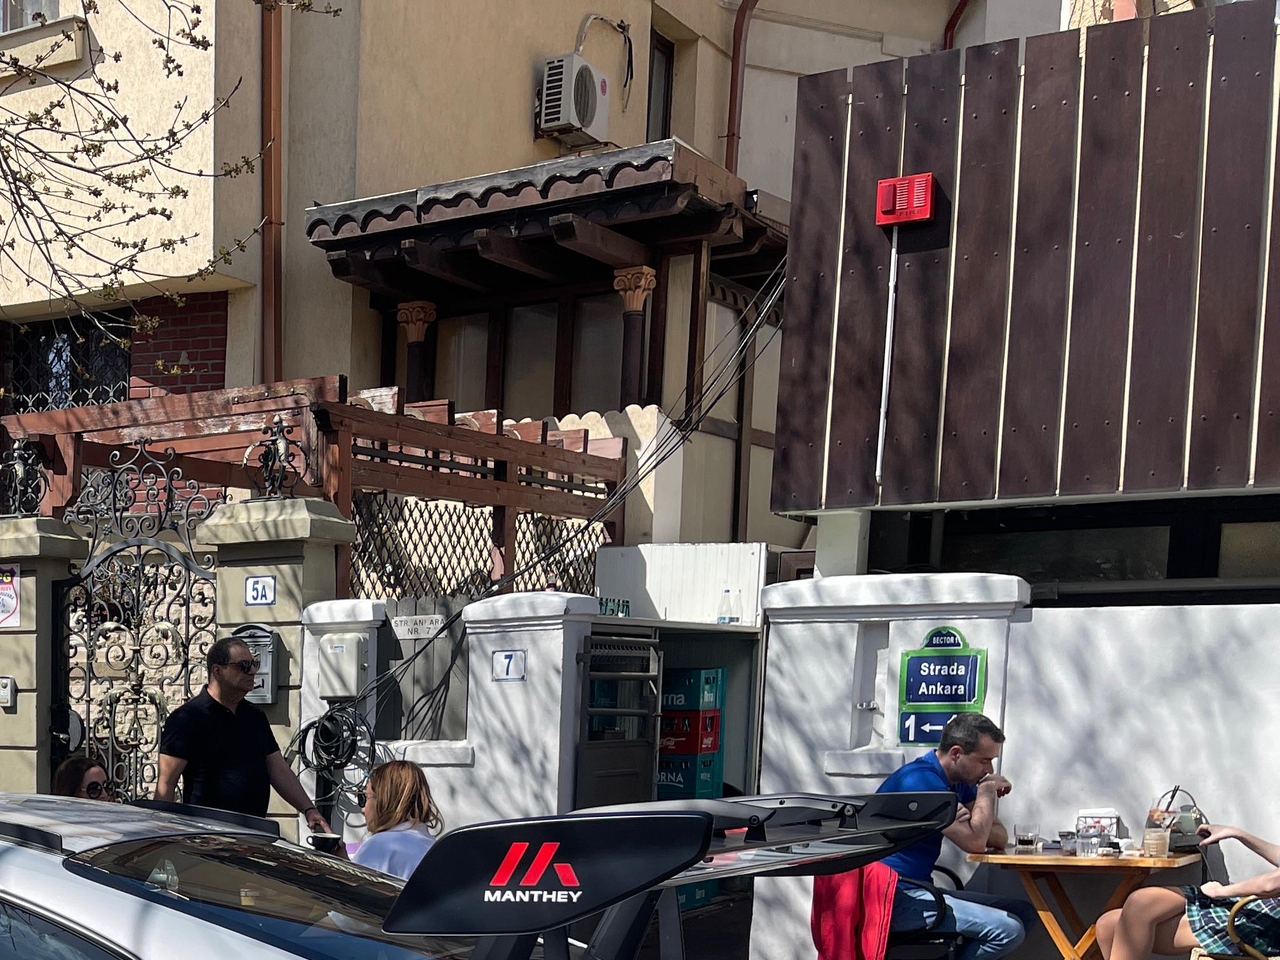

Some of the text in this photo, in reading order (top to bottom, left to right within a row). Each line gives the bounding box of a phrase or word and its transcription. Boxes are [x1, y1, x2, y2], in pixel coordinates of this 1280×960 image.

[252, 580, 267, 601] 5A
[932, 636, 955, 644] SECTOR
[504, 654, 513, 676] 7
[920, 662, 966, 676] Strada
[918, 682, 965, 695] Ankara
[905, 714, 916, 741] 1
[483, 890, 583, 902] MANTHEY
